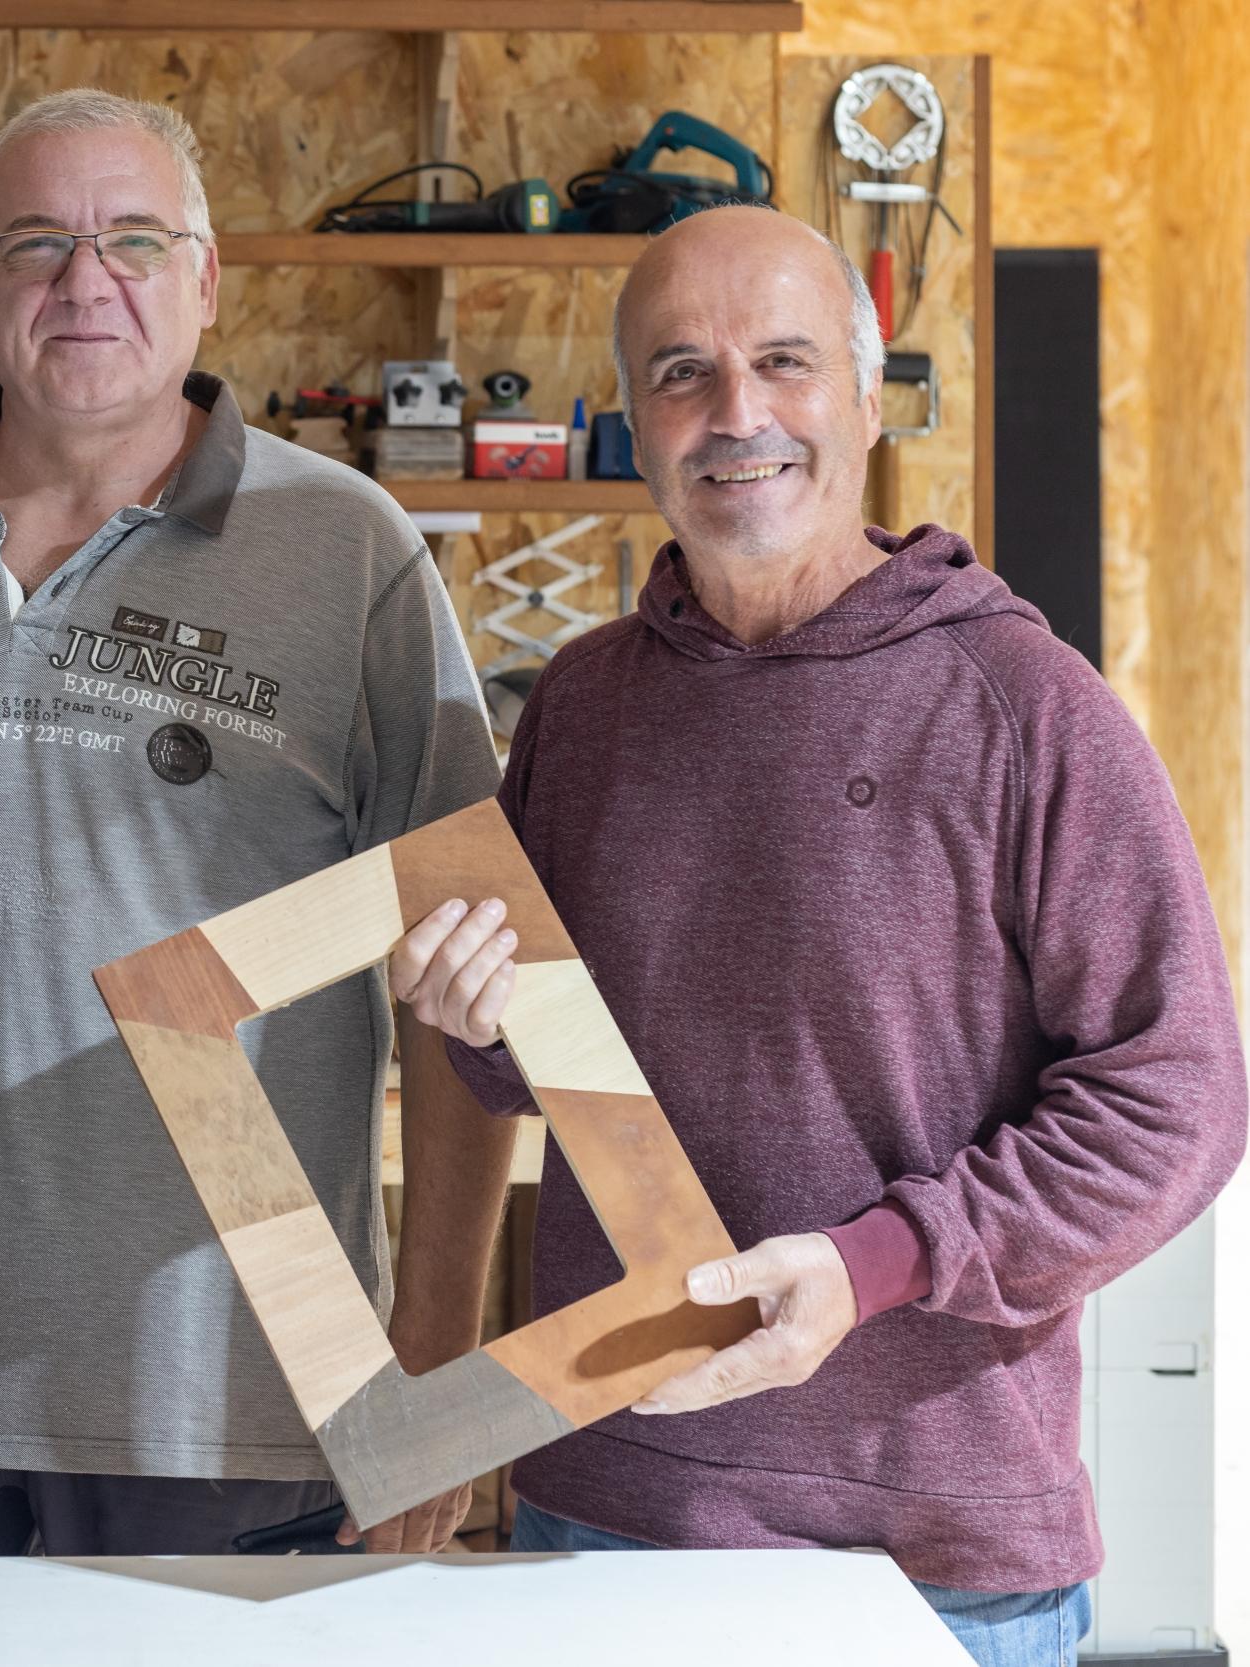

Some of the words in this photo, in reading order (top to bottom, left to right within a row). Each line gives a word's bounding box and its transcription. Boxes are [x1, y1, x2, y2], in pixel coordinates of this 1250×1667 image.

[50, 625, 280, 720] JUNGLE
[2, 706, 62, 723] Sector
[52, 698, 95, 715] Team
[101, 706, 134, 724] Cup
[62, 672, 199, 720] EXPLORING
[203, 706, 287, 749] FOREST
[78, 730, 125, 752] GMT
